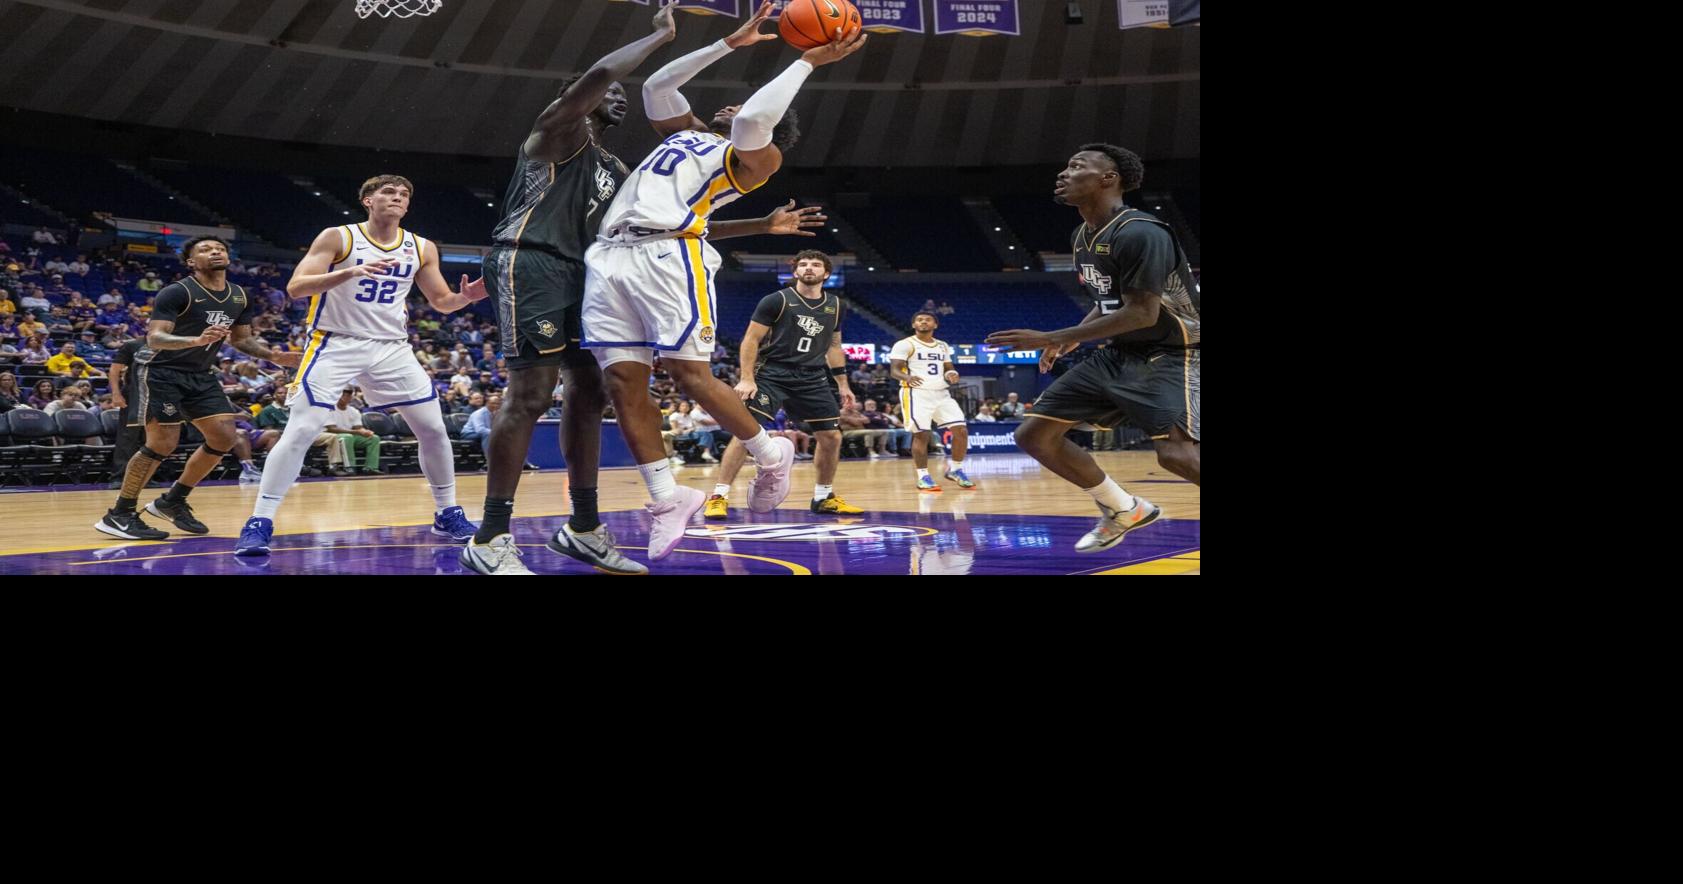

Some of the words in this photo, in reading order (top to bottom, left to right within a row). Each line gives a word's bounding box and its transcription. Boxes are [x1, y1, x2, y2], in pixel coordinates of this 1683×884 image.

[951, 3, 976, 11] FINAL
[978, 4, 1002, 12] FOUR
[863, 8, 902, 20] 2023
[957, 12, 996, 23] 2024
[1081, 264, 1112, 294] UCF
[355, 278, 398, 304] 32
[796, 314, 825, 337] UCF
[797, 336, 812, 353] 0
[917, 352, 945, 361] LSU
[986, 353, 996, 363] 7
[927, 363, 939, 376] 3
